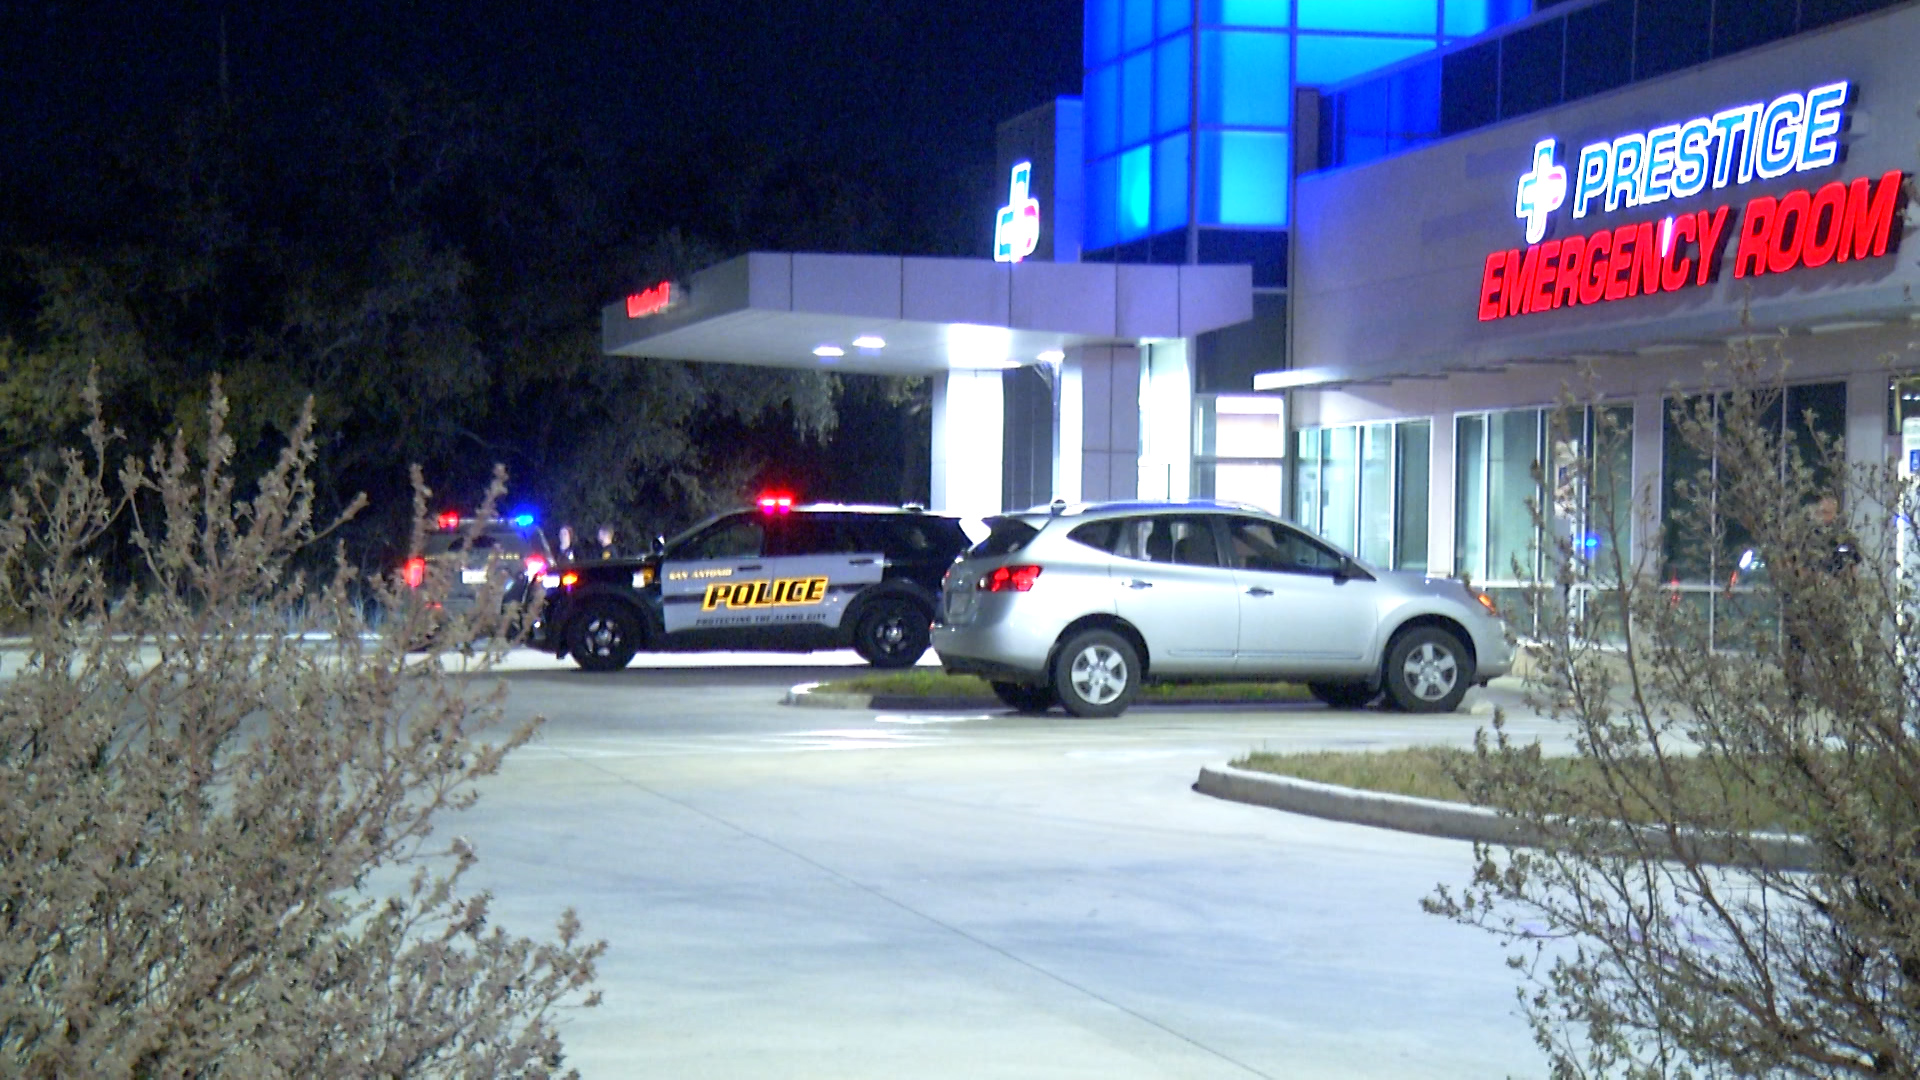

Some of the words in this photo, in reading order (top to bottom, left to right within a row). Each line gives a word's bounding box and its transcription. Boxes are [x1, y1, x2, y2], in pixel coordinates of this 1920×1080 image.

[1572, 81, 1850, 219] PRESTIGE
[1478, 204, 1730, 322] EMERGENCY
[1734, 170, 1902, 279] ROOM
[669, 571, 688, 580] SAN
[692, 568, 733, 579] ANTONIO
[702, 575, 829, 612] POLICE
